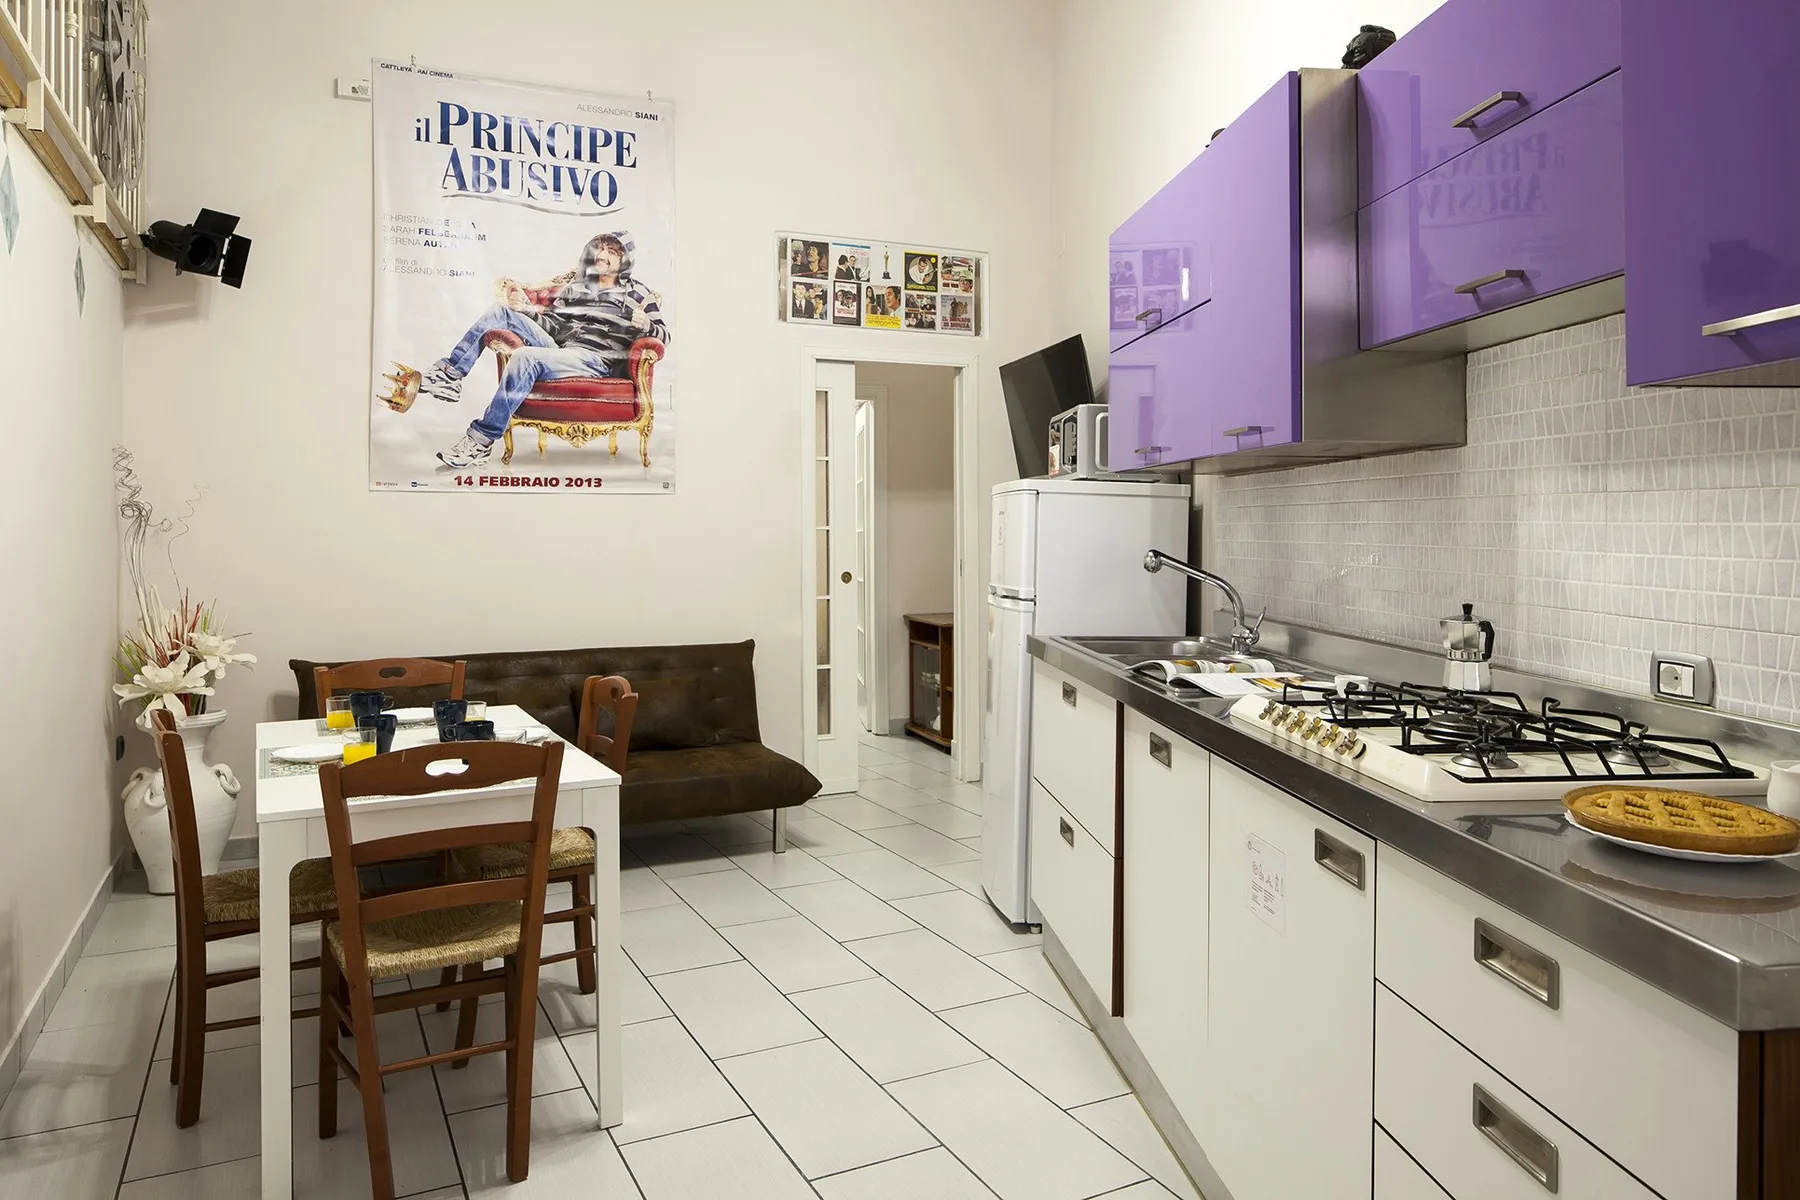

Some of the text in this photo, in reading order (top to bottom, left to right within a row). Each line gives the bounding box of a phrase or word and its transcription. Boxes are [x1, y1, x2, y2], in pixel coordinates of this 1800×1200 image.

[380, 62, 412, 73] CATTLEYA
[428, 70, 454, 79] CINEMA
[576, 103, 659, 121] ALESSANDRO SIANI
[415, 101, 637, 169] il PRINCIPE
[441, 146, 619, 208] ABUSIVO
[454, 475, 604, 488] 14 FEBBRAIO 2013
